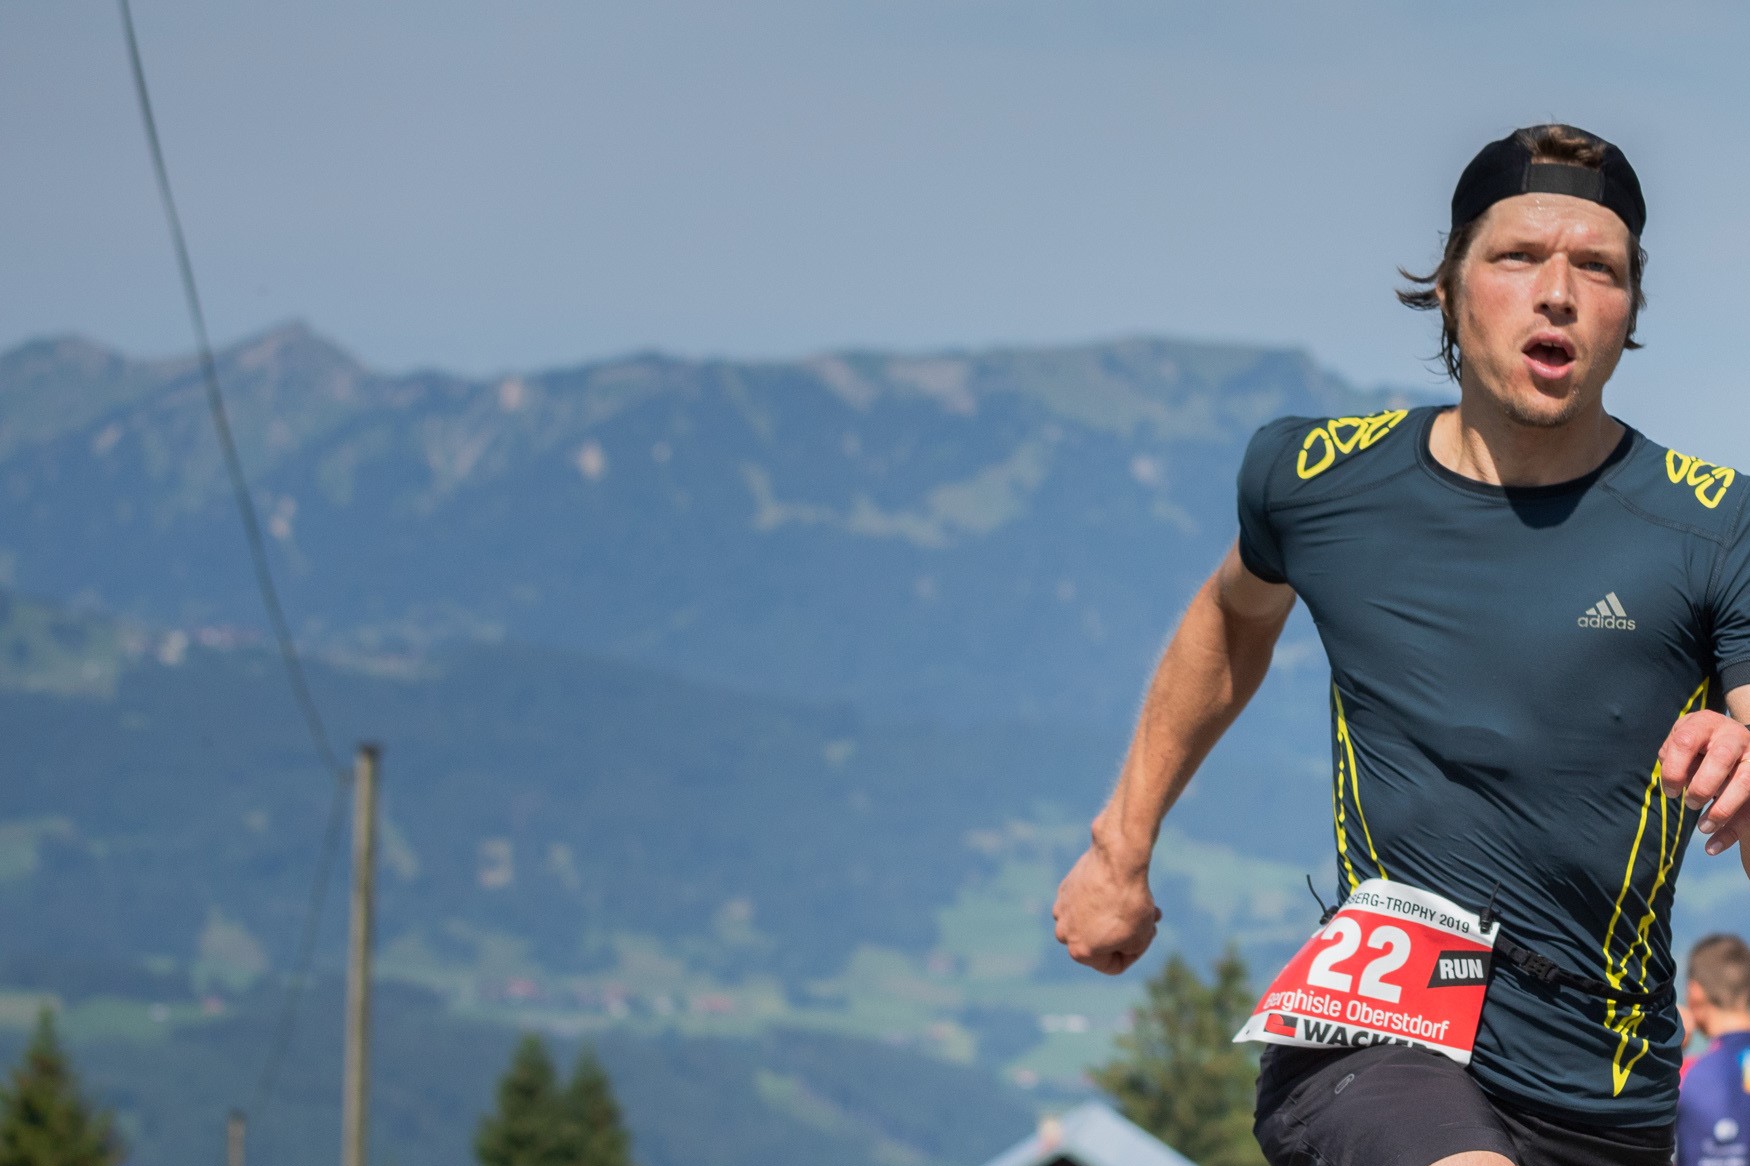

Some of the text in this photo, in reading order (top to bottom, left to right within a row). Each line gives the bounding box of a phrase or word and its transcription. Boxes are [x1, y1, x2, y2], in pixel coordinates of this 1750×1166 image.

[1577, 613, 1636, 630] adidas
[1346, 892, 1470, 934] BERG-TROPHY 2019
[1307, 917, 1412, 1004] 22
[1438, 958, 1484, 979] RUN
[1263, 988, 1451, 1041] Berghisle Oberstdorf
[1303, 1019, 1428, 1050] WACK
